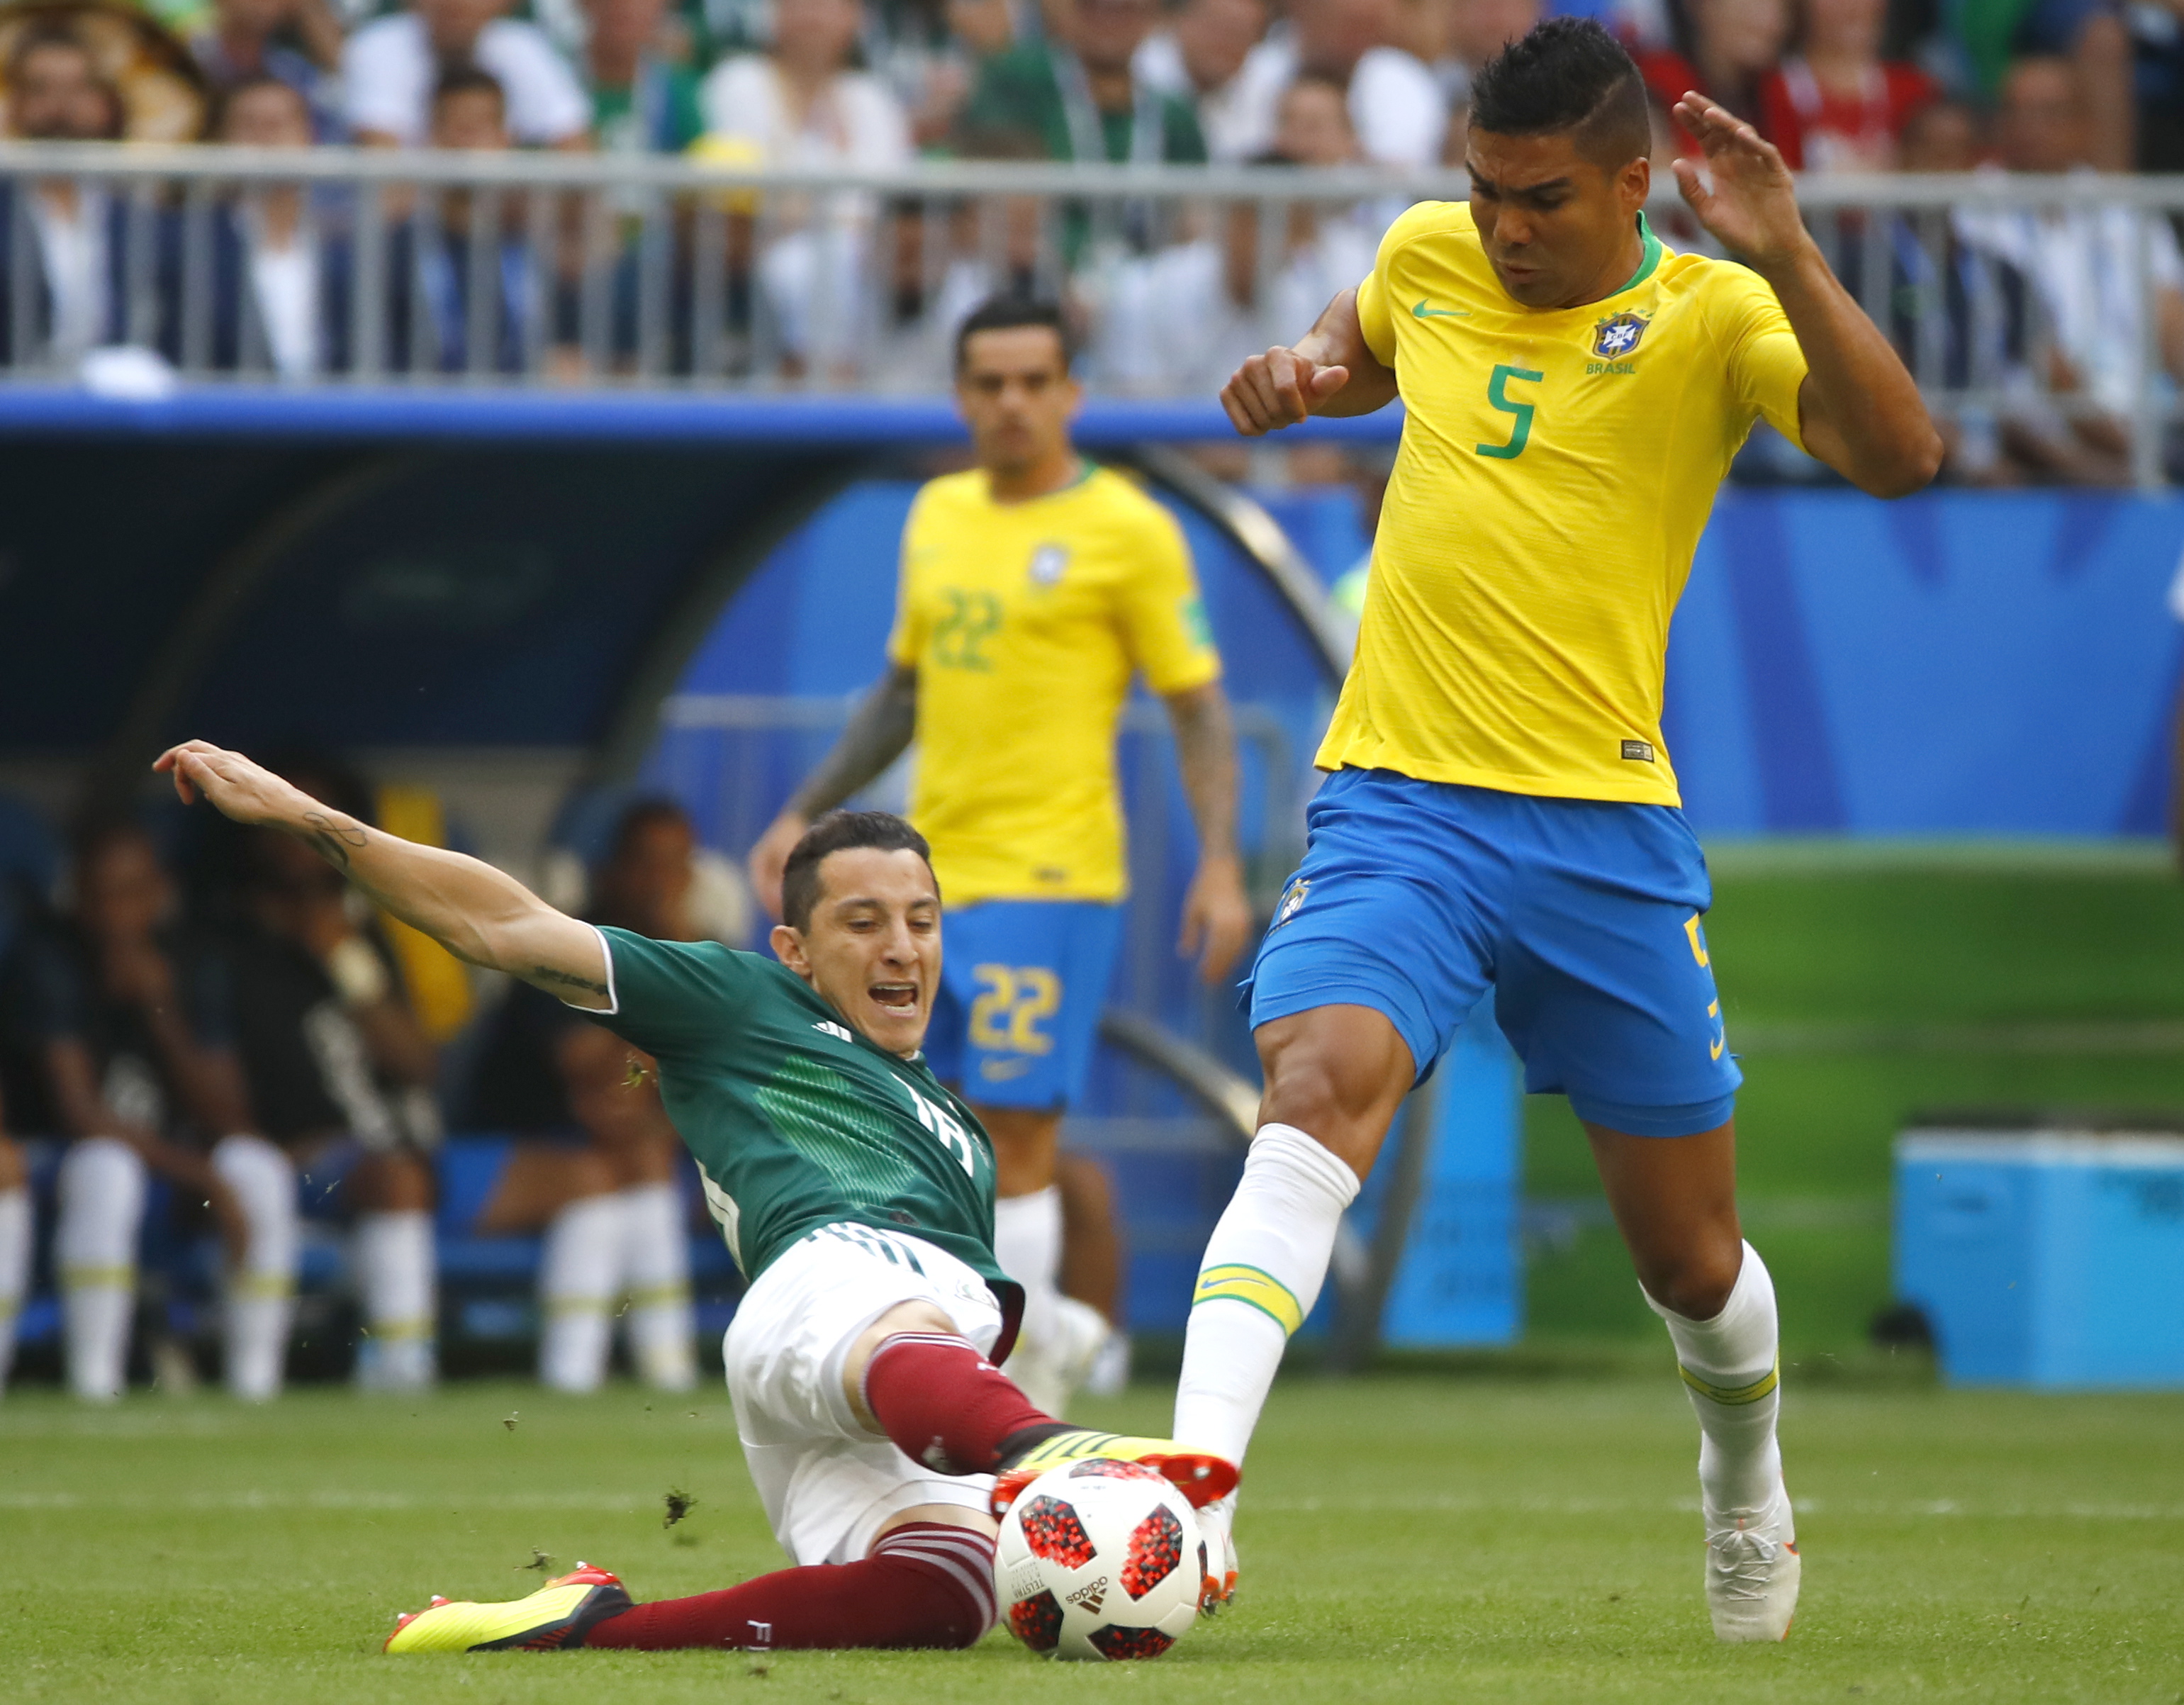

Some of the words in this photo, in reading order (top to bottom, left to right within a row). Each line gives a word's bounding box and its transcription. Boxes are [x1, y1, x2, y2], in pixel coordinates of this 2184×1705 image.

[1586, 362, 1635, 375] BRASIL
[1475, 364, 1544, 459] 5
[931, 588, 1002, 671] 22
[968, 963, 1061, 1056] 22
[1065, 1576, 1108, 1604] adidas
